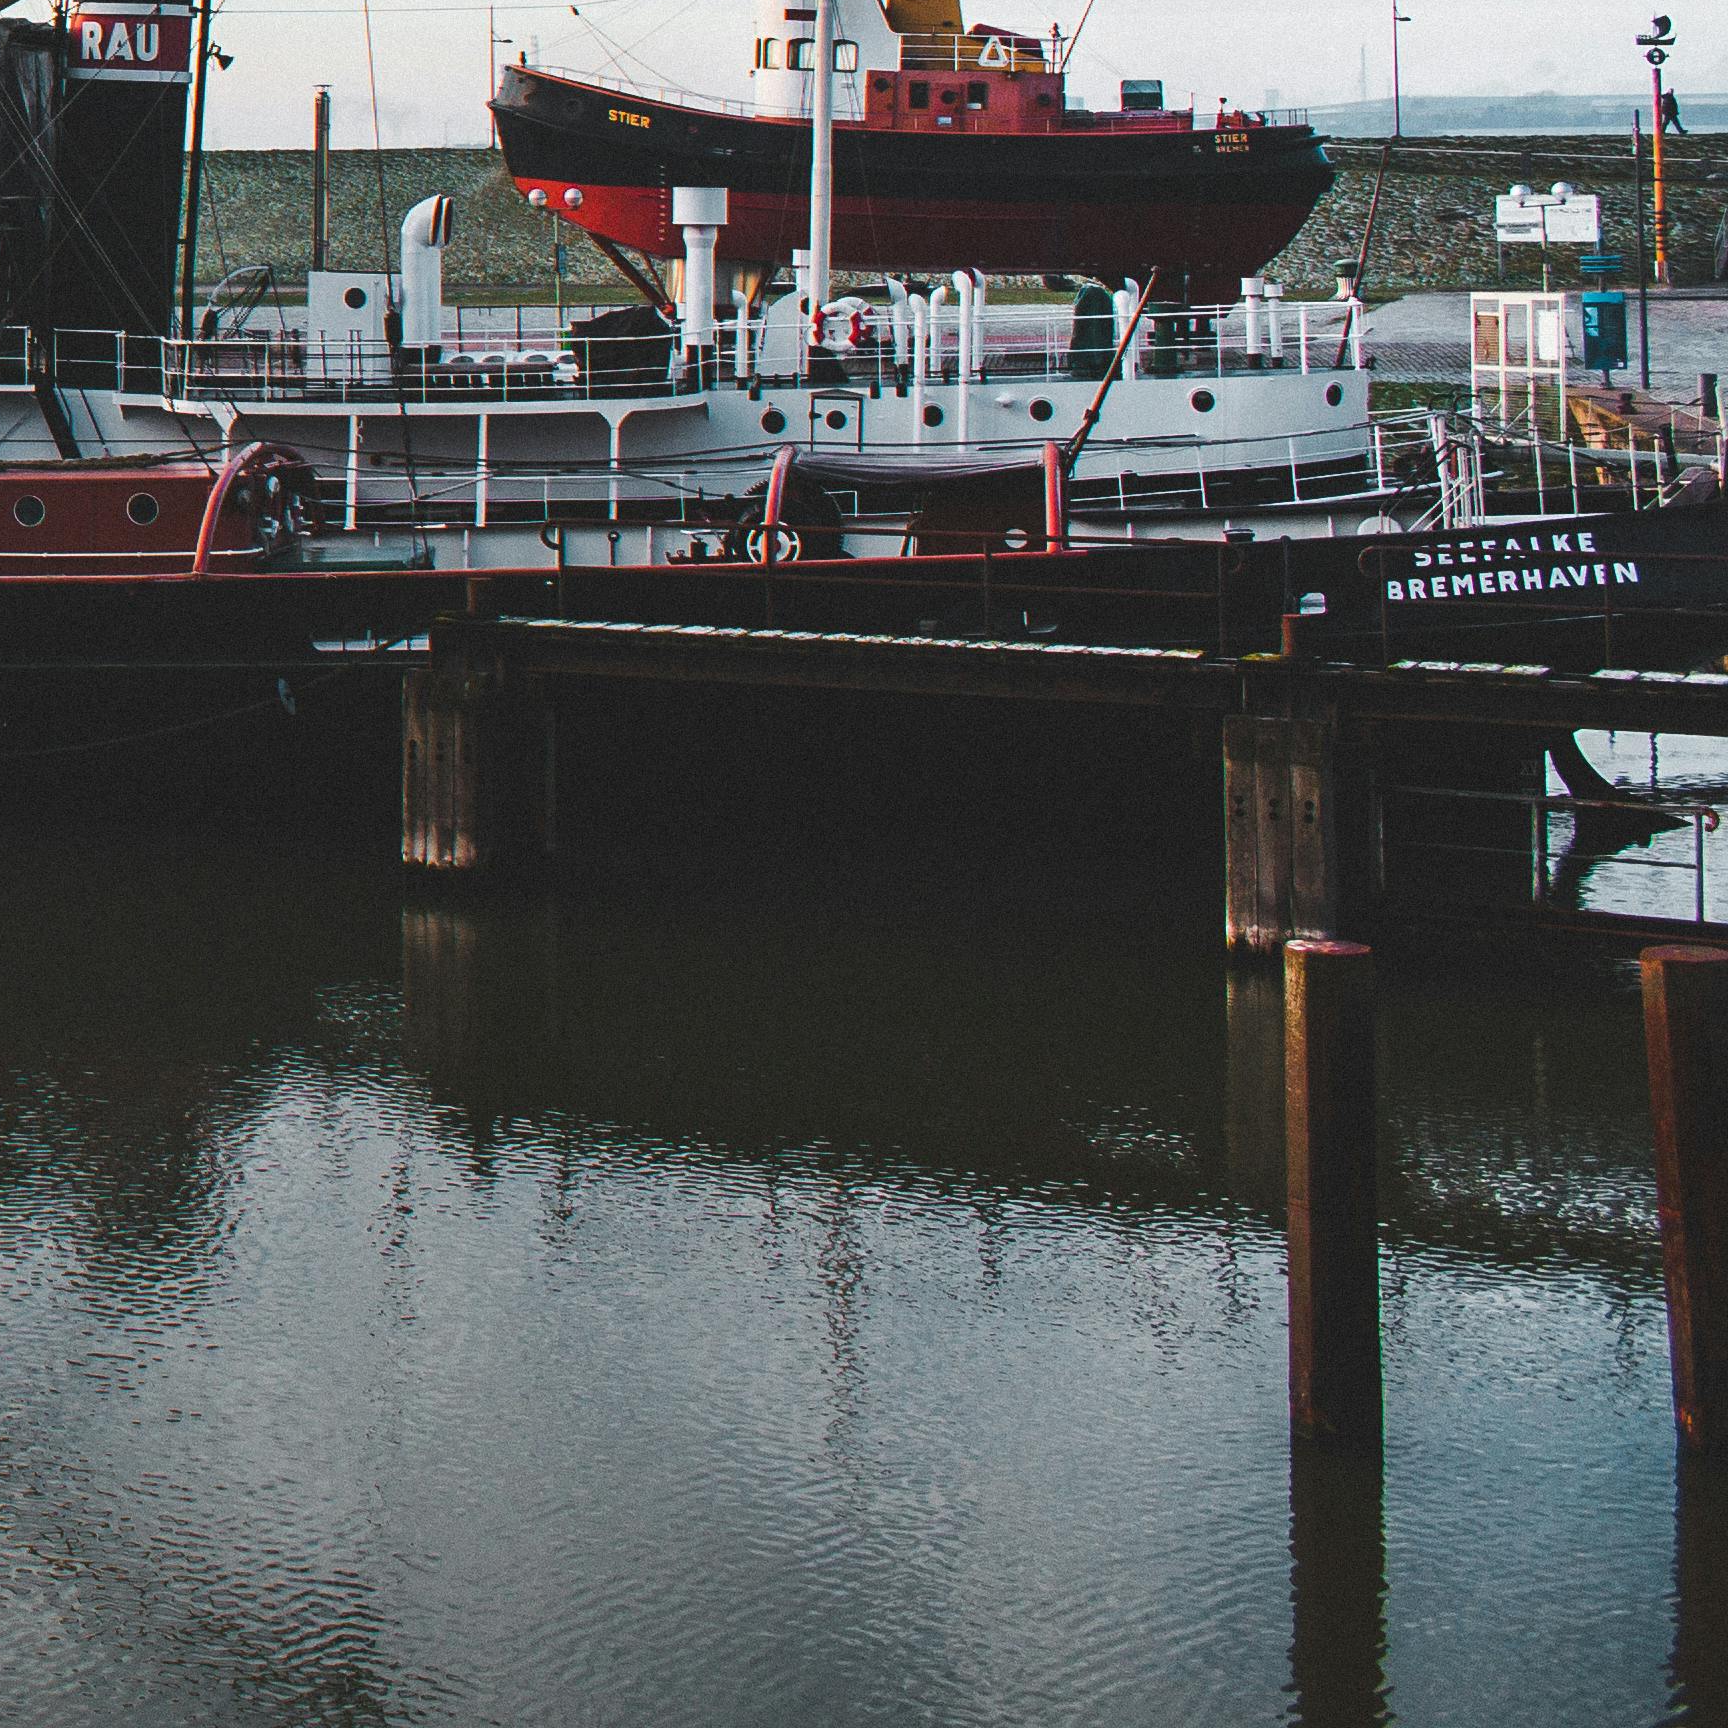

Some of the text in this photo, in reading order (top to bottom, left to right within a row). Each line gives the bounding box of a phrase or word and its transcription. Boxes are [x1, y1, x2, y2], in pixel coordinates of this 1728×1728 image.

[81, 21, 159, 62] RAU
[608, 109, 651, 129] STIER
[1215, 133, 1248, 144] STIER
[1387, 561, 1639, 601] BREMERHAVEN
